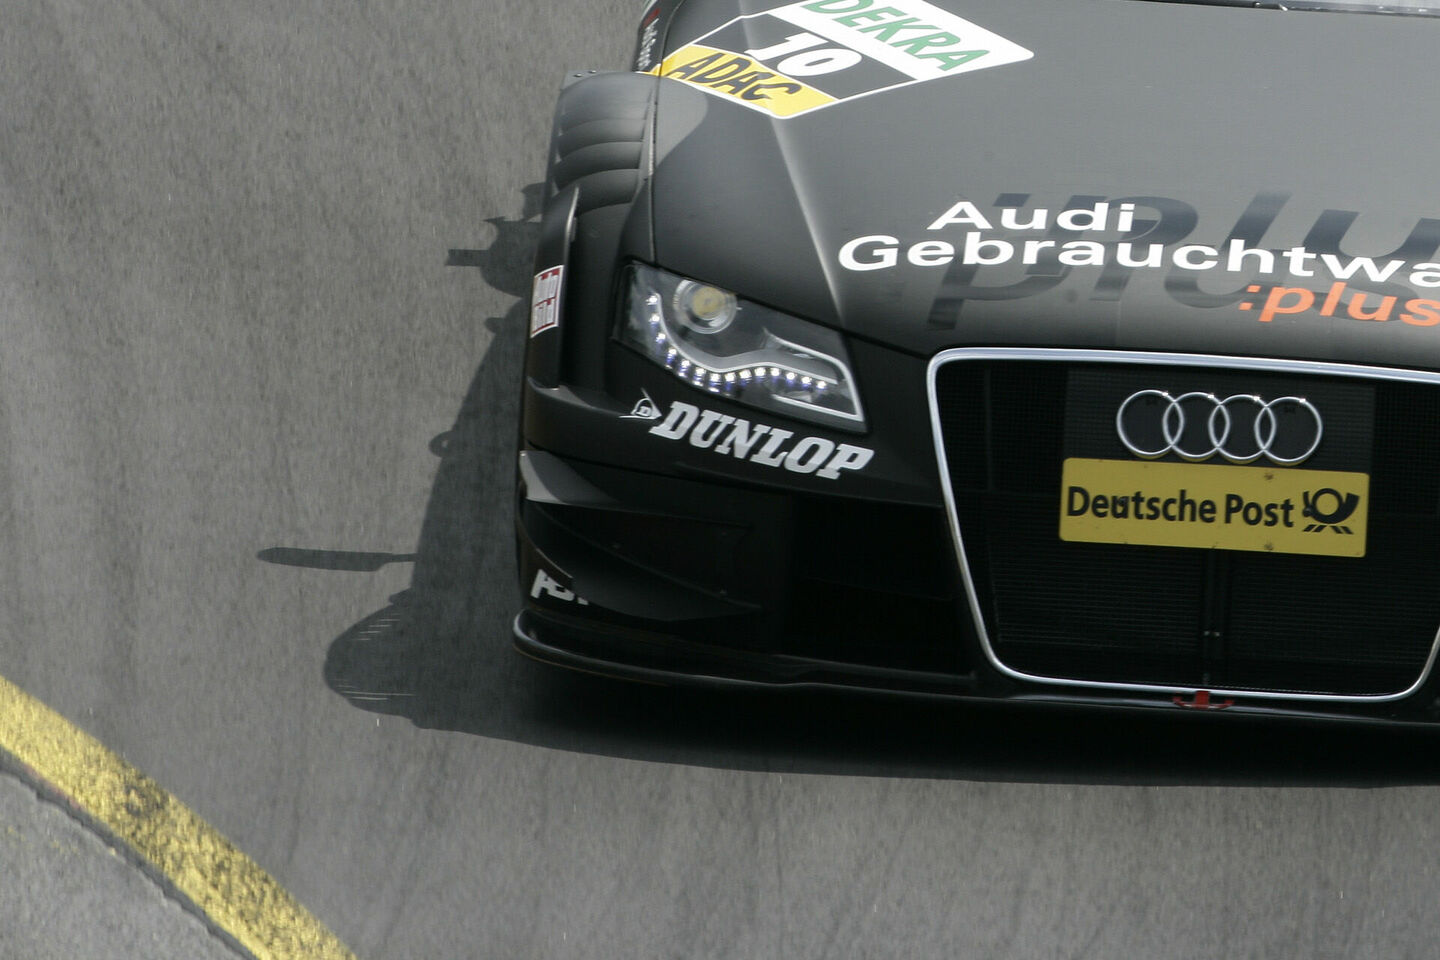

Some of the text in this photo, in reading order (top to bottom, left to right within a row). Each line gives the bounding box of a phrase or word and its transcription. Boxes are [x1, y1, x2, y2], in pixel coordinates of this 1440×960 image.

[666, 52, 802, 102] ADAC
[744, 33, 863, 77] 10
[926, 201, 1135, 232] Audi
[648, 401, 875, 480] DUNLOP
[1066, 486, 1294, 528] Deutsche Post
